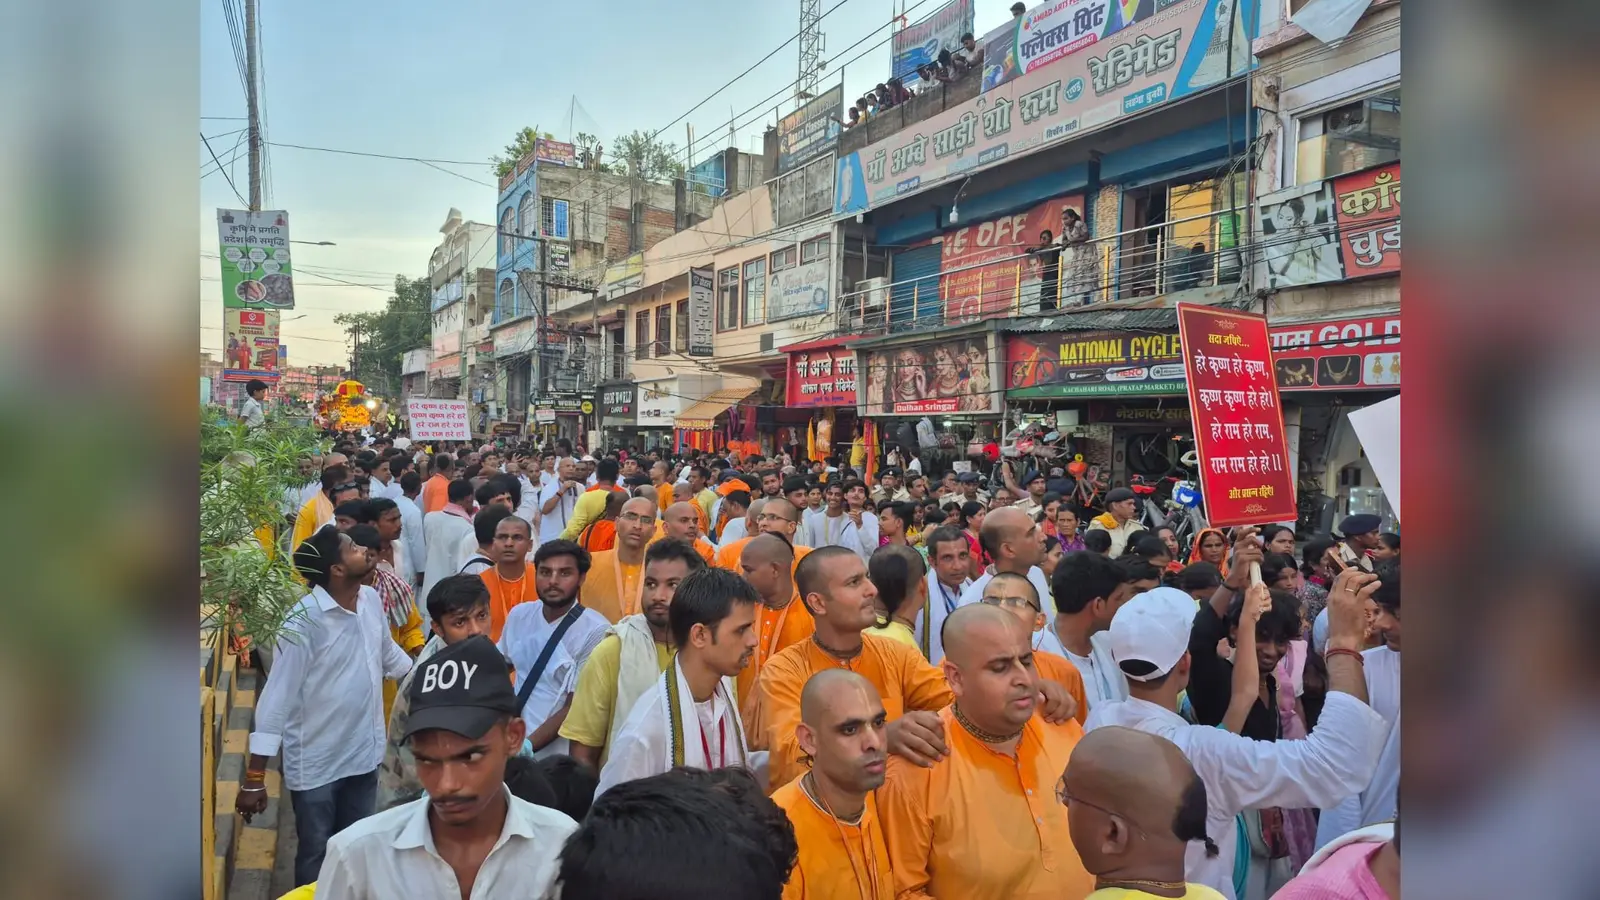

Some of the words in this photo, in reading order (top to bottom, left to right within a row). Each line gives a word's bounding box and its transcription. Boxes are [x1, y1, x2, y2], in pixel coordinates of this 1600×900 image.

[891, 133, 929, 175] अम्बे
[933, 111, 978, 158] साड़ी
[983, 97, 1013, 139] शो
[1020, 80, 1061, 124] रूम
[1087, 28, 1182, 95] रेडिमेड
[259, 225, 280, 235] प्रगति
[976, 213, 1029, 247] OFF
[1059, 338, 1126, 366] NATIONAL
[1130, 335, 1181, 361] CYCLE
[1208, 333, 1222, 344] सदा
[810, 351, 833, 377] अम्बे
[1195, 348, 1207, 375] हरे
[1208, 356, 1231, 379] कृष्ण
[1231, 352, 1244, 377] हरे
[1244, 359, 1269, 380] कृष्ण,
[1118, 383, 1143, 392] (PRATAP
[1144, 383, 1175, 391] MARKET)
[1199, 388, 1223, 411] कृष्ण
[1224, 390, 1247, 412] कृष्ण
[1246, 385, 1259, 410] हरे
[421, 403, 437, 411] कृष्ण
[896, 403, 923, 412] Dulhan
[924, 402, 956, 412] Sringar
[1210, 416, 1223, 443] हरे
[1224, 423, 1242, 440] राम
[1242, 417, 1254, 443] हरे
[1254, 423, 1274, 443] राम,
[1210, 457, 1229, 475] राम
[1229, 456, 1247, 474] राम
[1247, 449, 1260, 476] हरे
[1259, 449, 1271, 475] हरे
[421, 659, 479, 694] BOY
